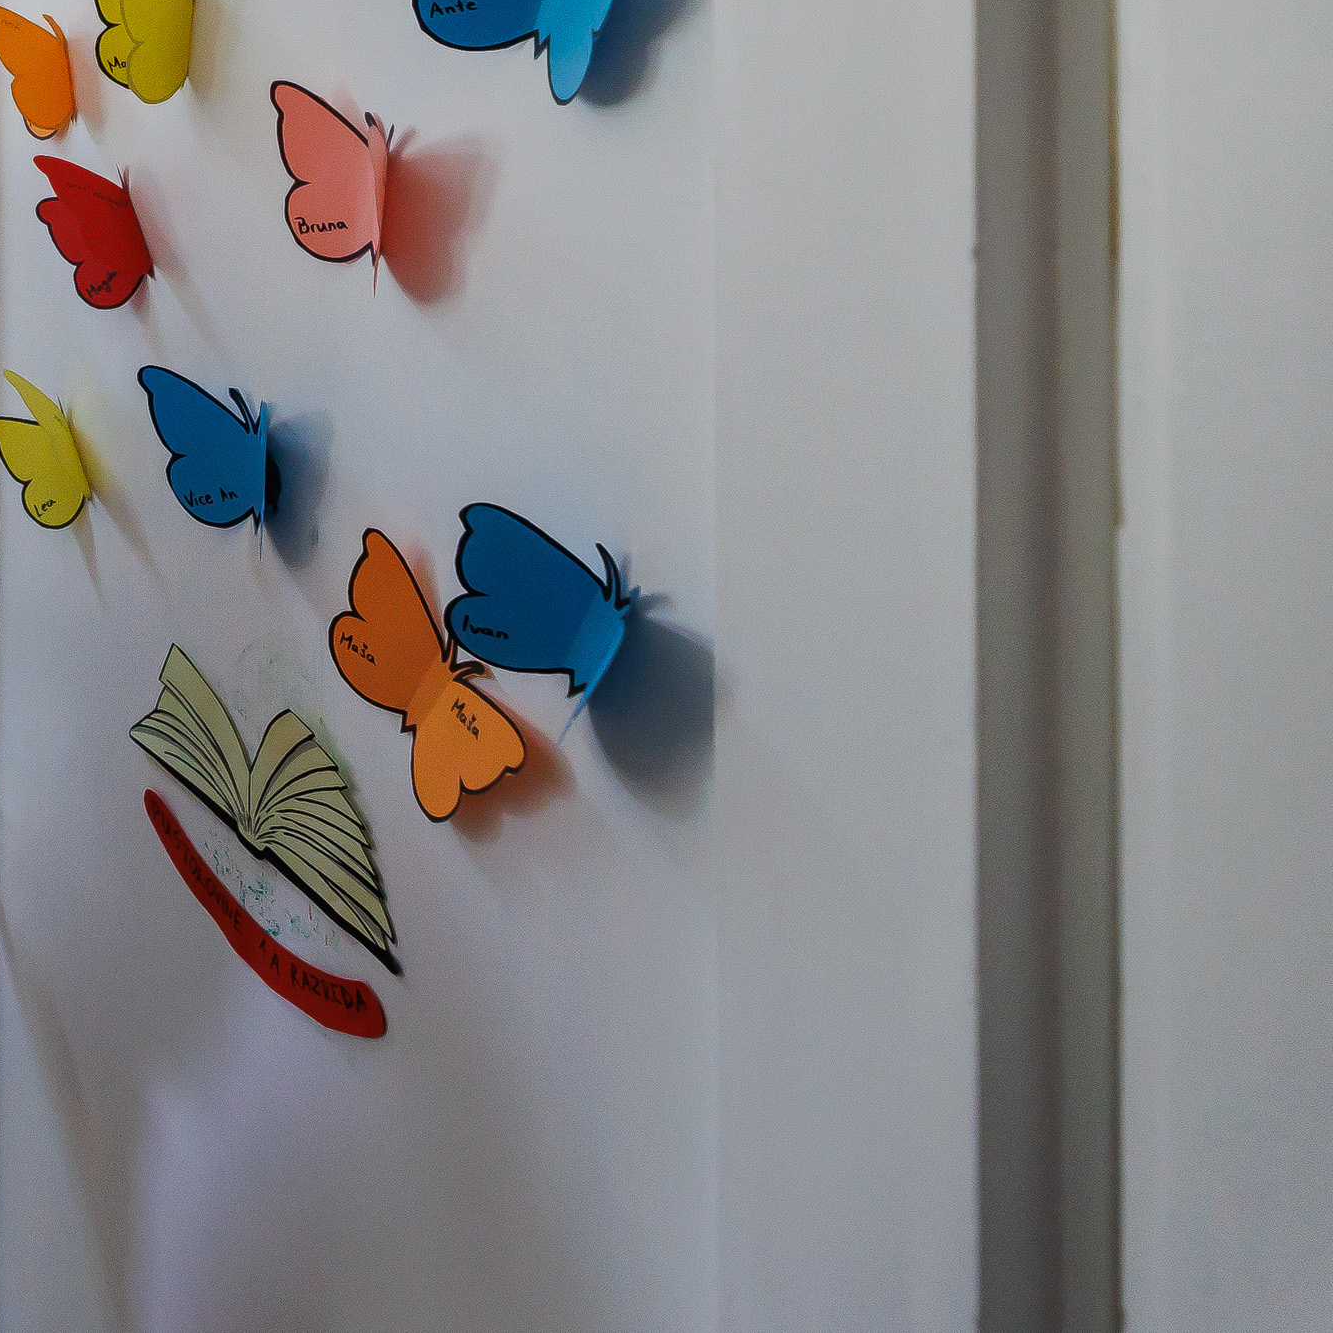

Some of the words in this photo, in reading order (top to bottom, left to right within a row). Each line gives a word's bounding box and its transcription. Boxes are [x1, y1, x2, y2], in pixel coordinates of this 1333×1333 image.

[430, 0, 478, 18] Ante
[294, 216, 348, 235] Bruna
[33, 499, 57, 517] Lea
[183, 489, 214, 508] Vice
[461, 614, 509, 641] Ivan
[339, 630, 377, 667] Maša
[451, 696, 480, 742] Maša
[258, 937, 267, 961] 1
[269, 952, 281, 976] A
[289, 961, 368, 1013] RAZREDA
